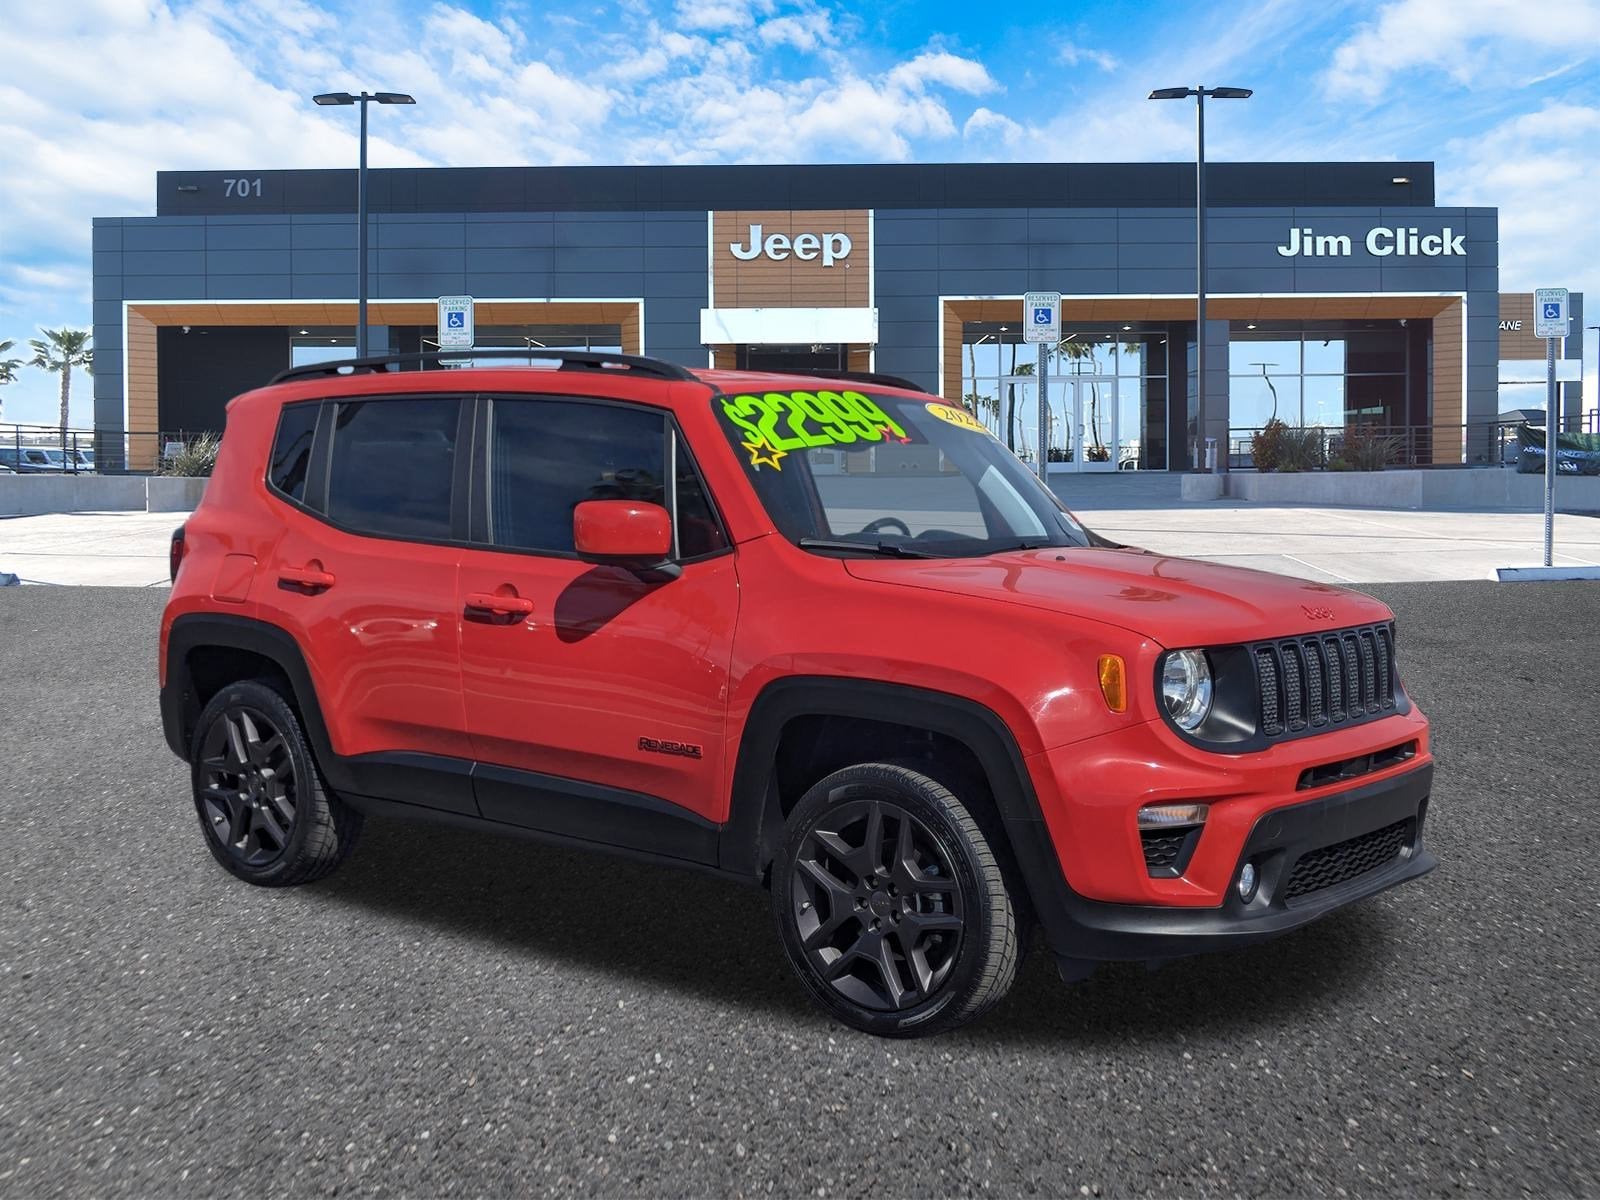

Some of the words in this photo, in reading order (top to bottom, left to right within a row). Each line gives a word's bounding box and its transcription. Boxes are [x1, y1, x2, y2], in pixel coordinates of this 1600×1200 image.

[223, 178, 262, 197] 701
[730, 224, 852, 268] Jeep
[1277, 228, 1352, 257] Jim
[1366, 227, 1467, 257] Click
[720, 390, 907, 451] $22999
[638, 736, 703, 760] RENEGADE
